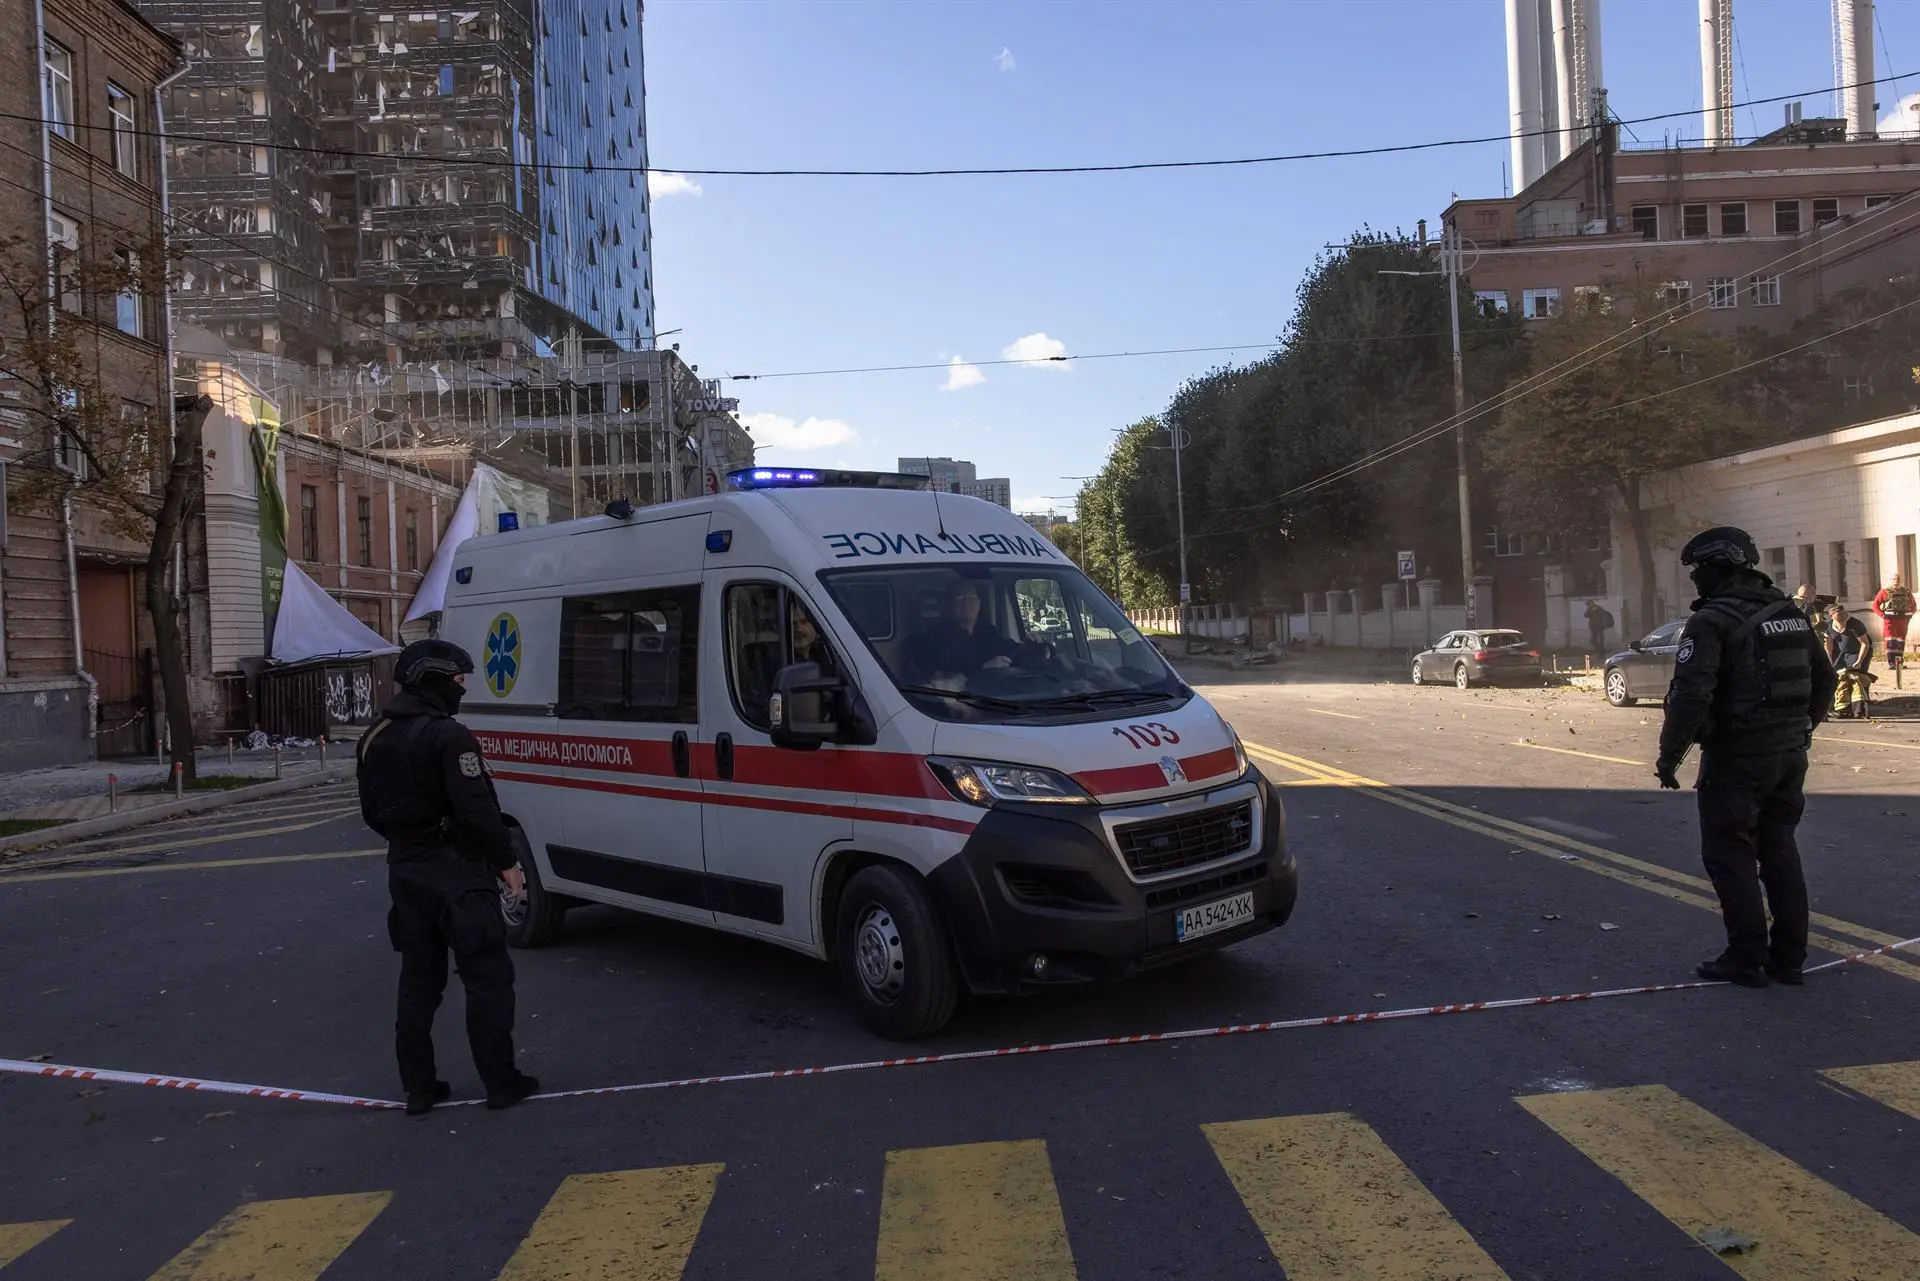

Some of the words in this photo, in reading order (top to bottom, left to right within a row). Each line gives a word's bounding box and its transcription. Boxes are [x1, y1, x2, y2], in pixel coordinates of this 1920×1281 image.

[1112, 722, 1180, 749] 103
[504, 738, 559, 759] МЕДИЧНА
[561, 742, 633, 766] ДОПОМОГА
[1185, 910, 1203, 932] AA
[1206, 900, 1234, 925] 5424
[1235, 895, 1251, 917] XK
